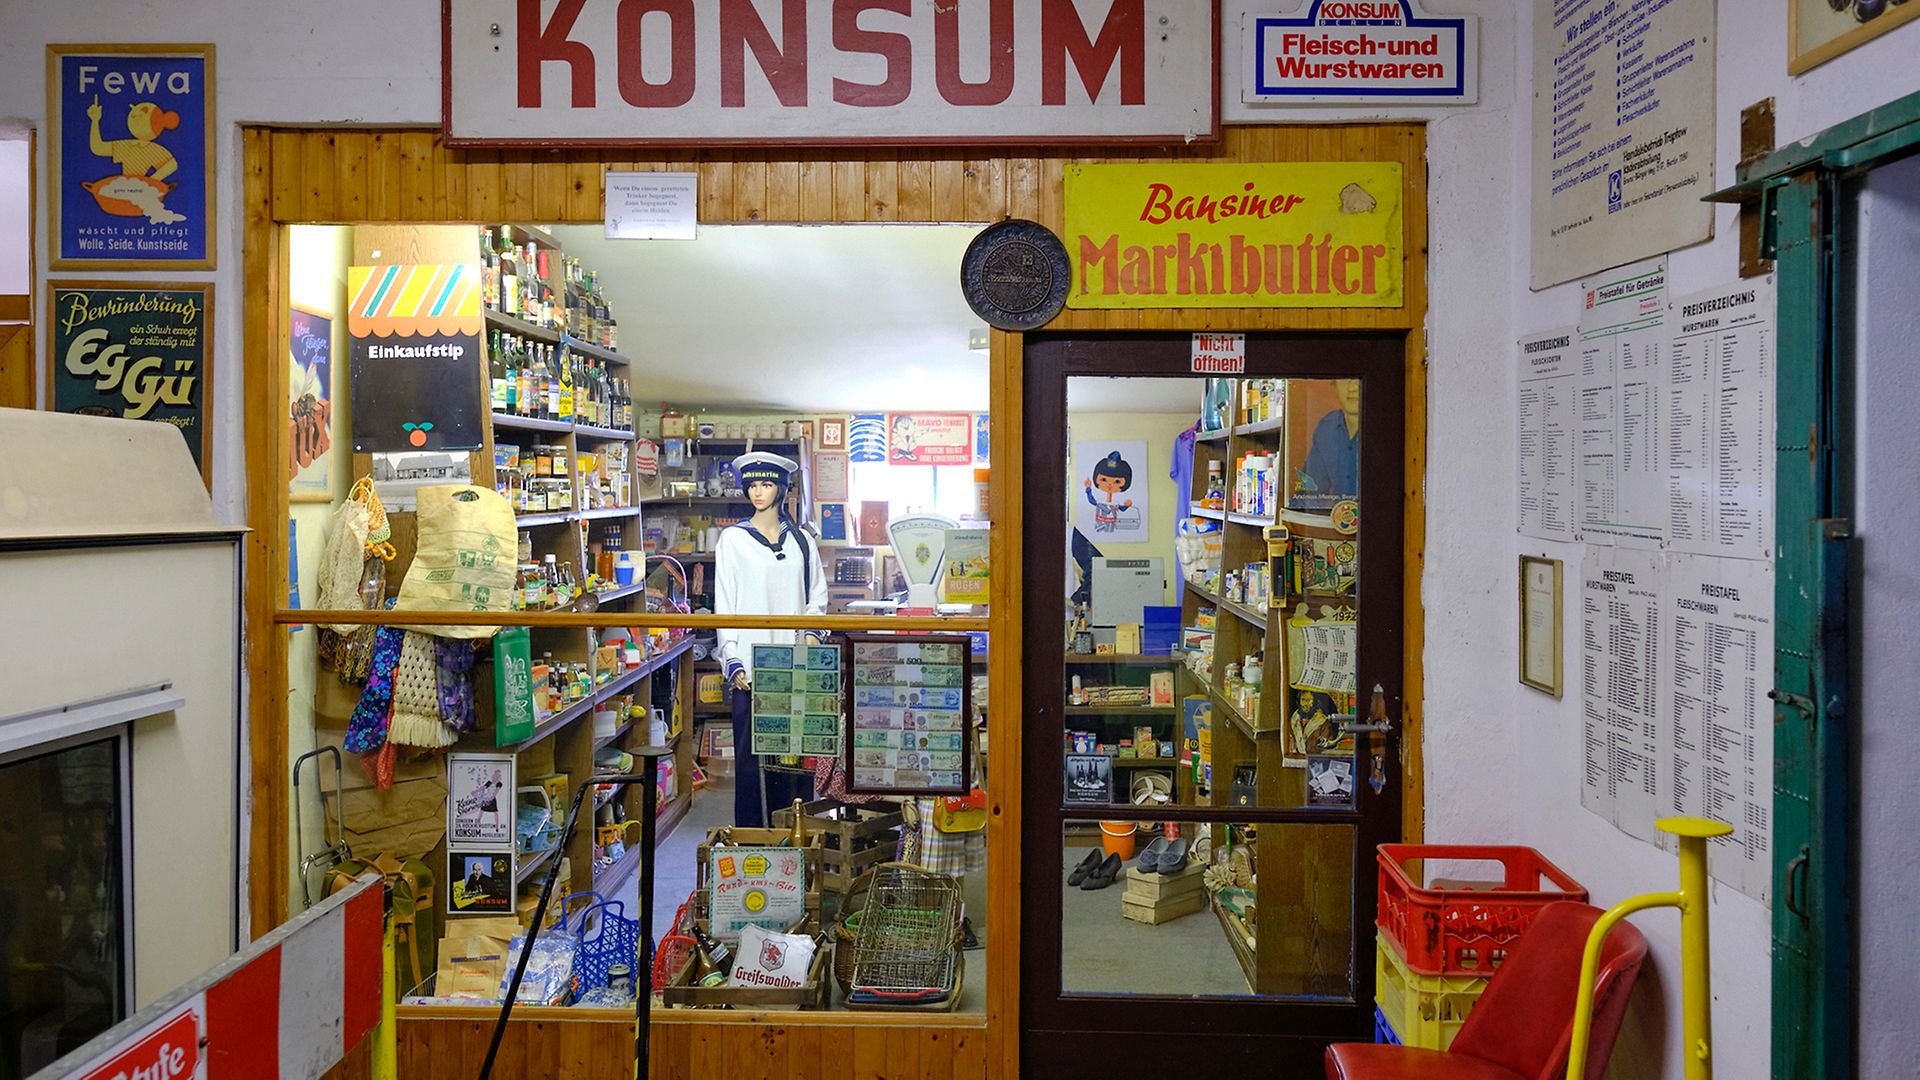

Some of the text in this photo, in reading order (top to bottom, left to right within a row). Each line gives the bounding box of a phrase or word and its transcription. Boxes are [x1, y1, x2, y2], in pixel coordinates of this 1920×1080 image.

[1321, 3, 1399, 18] KONSUM
[1566, 25, 1579, 43] Wir
[1579, 10, 1603, 34] stellen
[1604, 0, 1615, 17] ein
[517, 0, 1146, 108] KONSUM
[1283, 34, 1438, 56] Fleisch-und
[1276, 57, 1444, 79] Wurstwaren
[79, 66, 190, 95] Fewa
[1140, 183, 1305, 224] Bansiner
[78, 226, 189, 238] wäscht und pflegt
[137, 238, 189, 251] Kunstseide
[1599, 284, 1625, 301] Preistafel
[1625, 282, 1635, 295] für
[1636, 276, 1665, 292] Getränke
[1682, 290, 1756, 318] PREISVERZEICHNIS
[130, 324, 197, 335] ein Schuh erregt
[1682, 318, 1720, 333] WURSTWAREN
[129, 337, 196, 348] der ständig mit
[368, 343, 464, 361] Einkaufstip
[1199, 334, 1236, 353] Nicht
[1524, 335, 1570, 354] PREISVERZEICHNIS
[1193, 354, 1244, 373] öffnen!
[917, 419, 943, 427] MAYO
[1603, 570, 1635, 585] PREISTAFEL
[1701, 583, 1740, 602] PREISTAFEL
[1677, 598, 1719, 615] FLEISCHWAREN
[454, 828, 482, 838] KONSUM
